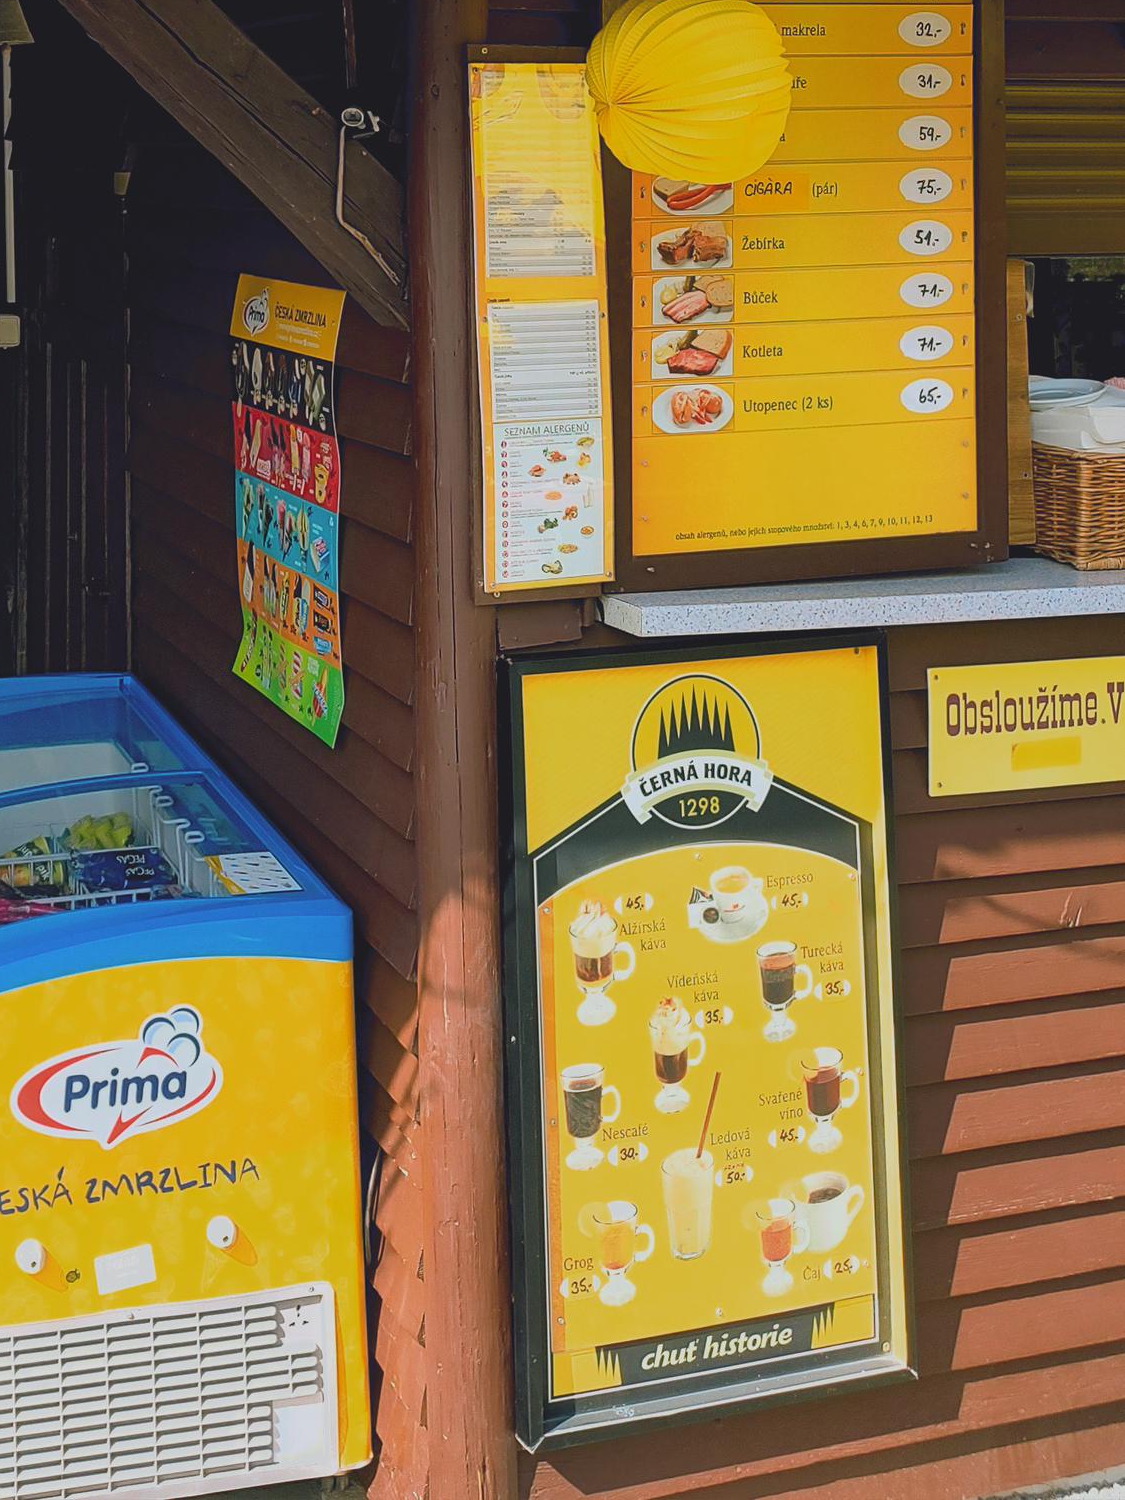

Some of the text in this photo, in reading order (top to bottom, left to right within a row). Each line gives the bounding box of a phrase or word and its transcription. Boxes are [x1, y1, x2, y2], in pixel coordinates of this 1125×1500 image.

[781, 23, 826, 36] makrela
[812, 182, 838, 197] (pár)
[741, 235, 785, 251] Žebírka
[743, 291, 778, 304] Bůček
[742, 345, 783, 358] Kotleta
[743, 396, 833, 415] Utopenec (2 ks)
[504, 426, 541, 437] SEZNAM
[543, 421, 589, 434] ALERGENŮ
[638, 760, 752, 797] ČERNÁ HORA
[679, 796, 720, 818] 1298
[766, 872, 814, 889] Espresso
[619, 918, 666, 936] Alžírská
[640, 938, 666, 951] káva
[800, 941, 843, 959] Turecká
[820, 961, 844, 974] káva
[667, 971, 719, 989] Vídeňská
[693, 990, 719, 1003] káva
[63, 1067, 188, 1114] Prima
[759, 1088, 802, 1106] Svařené
[779, 1107, 803, 1120] víno
[602, 1123, 648, 1141] Nescafé
[710, 1127, 751, 1145] Ledová
[726, 1147, 751, 1161] káva
[85, 1158, 261, 1204] ZMRZLINA
[564, 1257, 594, 1272] Grog
[802, 1265, 821, 1281] Čaj
[641, 1324, 793, 1370] chuť historie
